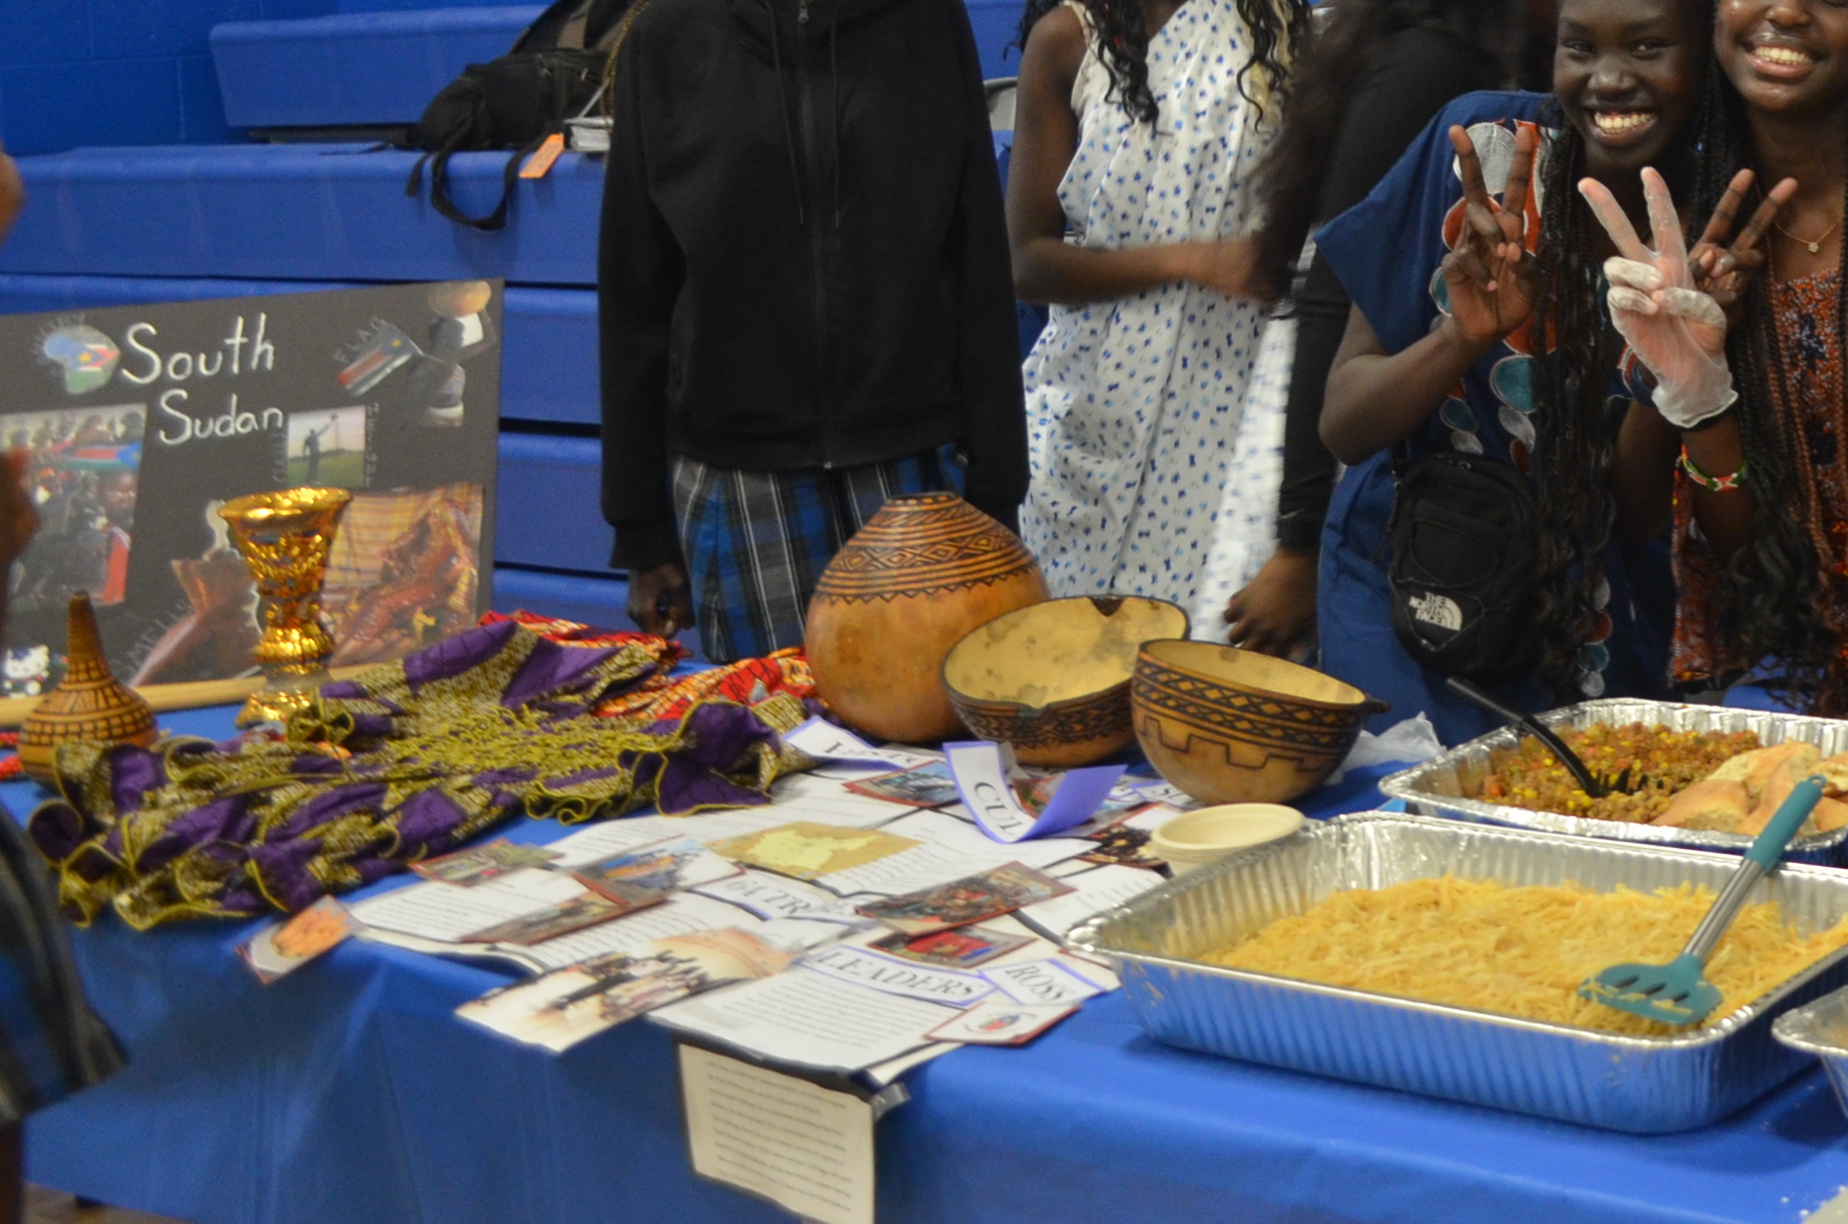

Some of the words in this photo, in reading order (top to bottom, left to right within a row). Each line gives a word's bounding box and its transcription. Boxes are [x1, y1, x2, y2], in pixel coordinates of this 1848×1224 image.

[121, 311, 275, 384] South
[159, 388, 284, 445] Sudan
[817, 951, 985, 995] LEADERS
[1004, 964, 1076, 1001] ROSS
